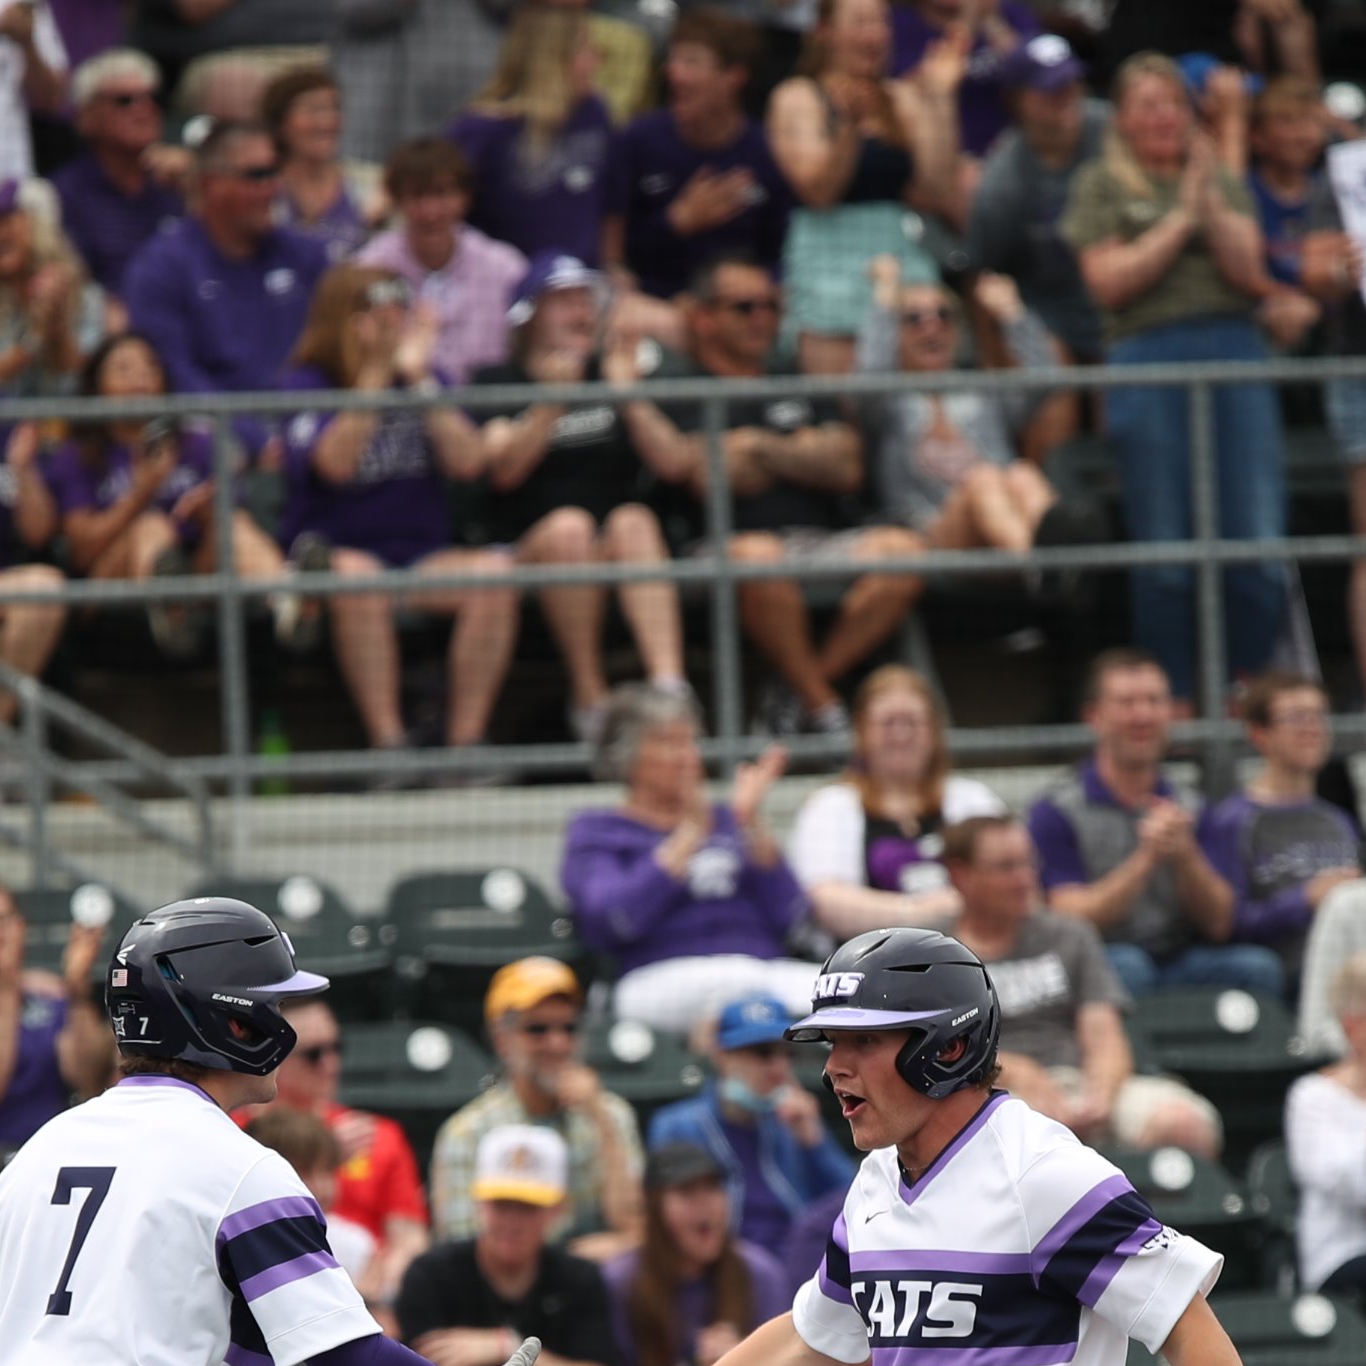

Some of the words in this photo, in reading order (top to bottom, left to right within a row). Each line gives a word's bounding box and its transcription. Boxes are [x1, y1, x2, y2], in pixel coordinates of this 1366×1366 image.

[812, 972, 866, 1001] ATS
[212, 993, 254, 1007] EASTON
[139, 1017, 149, 1036] 7
[952, 1007, 979, 1027] EASTON
[45, 1166, 117, 1316] 7
